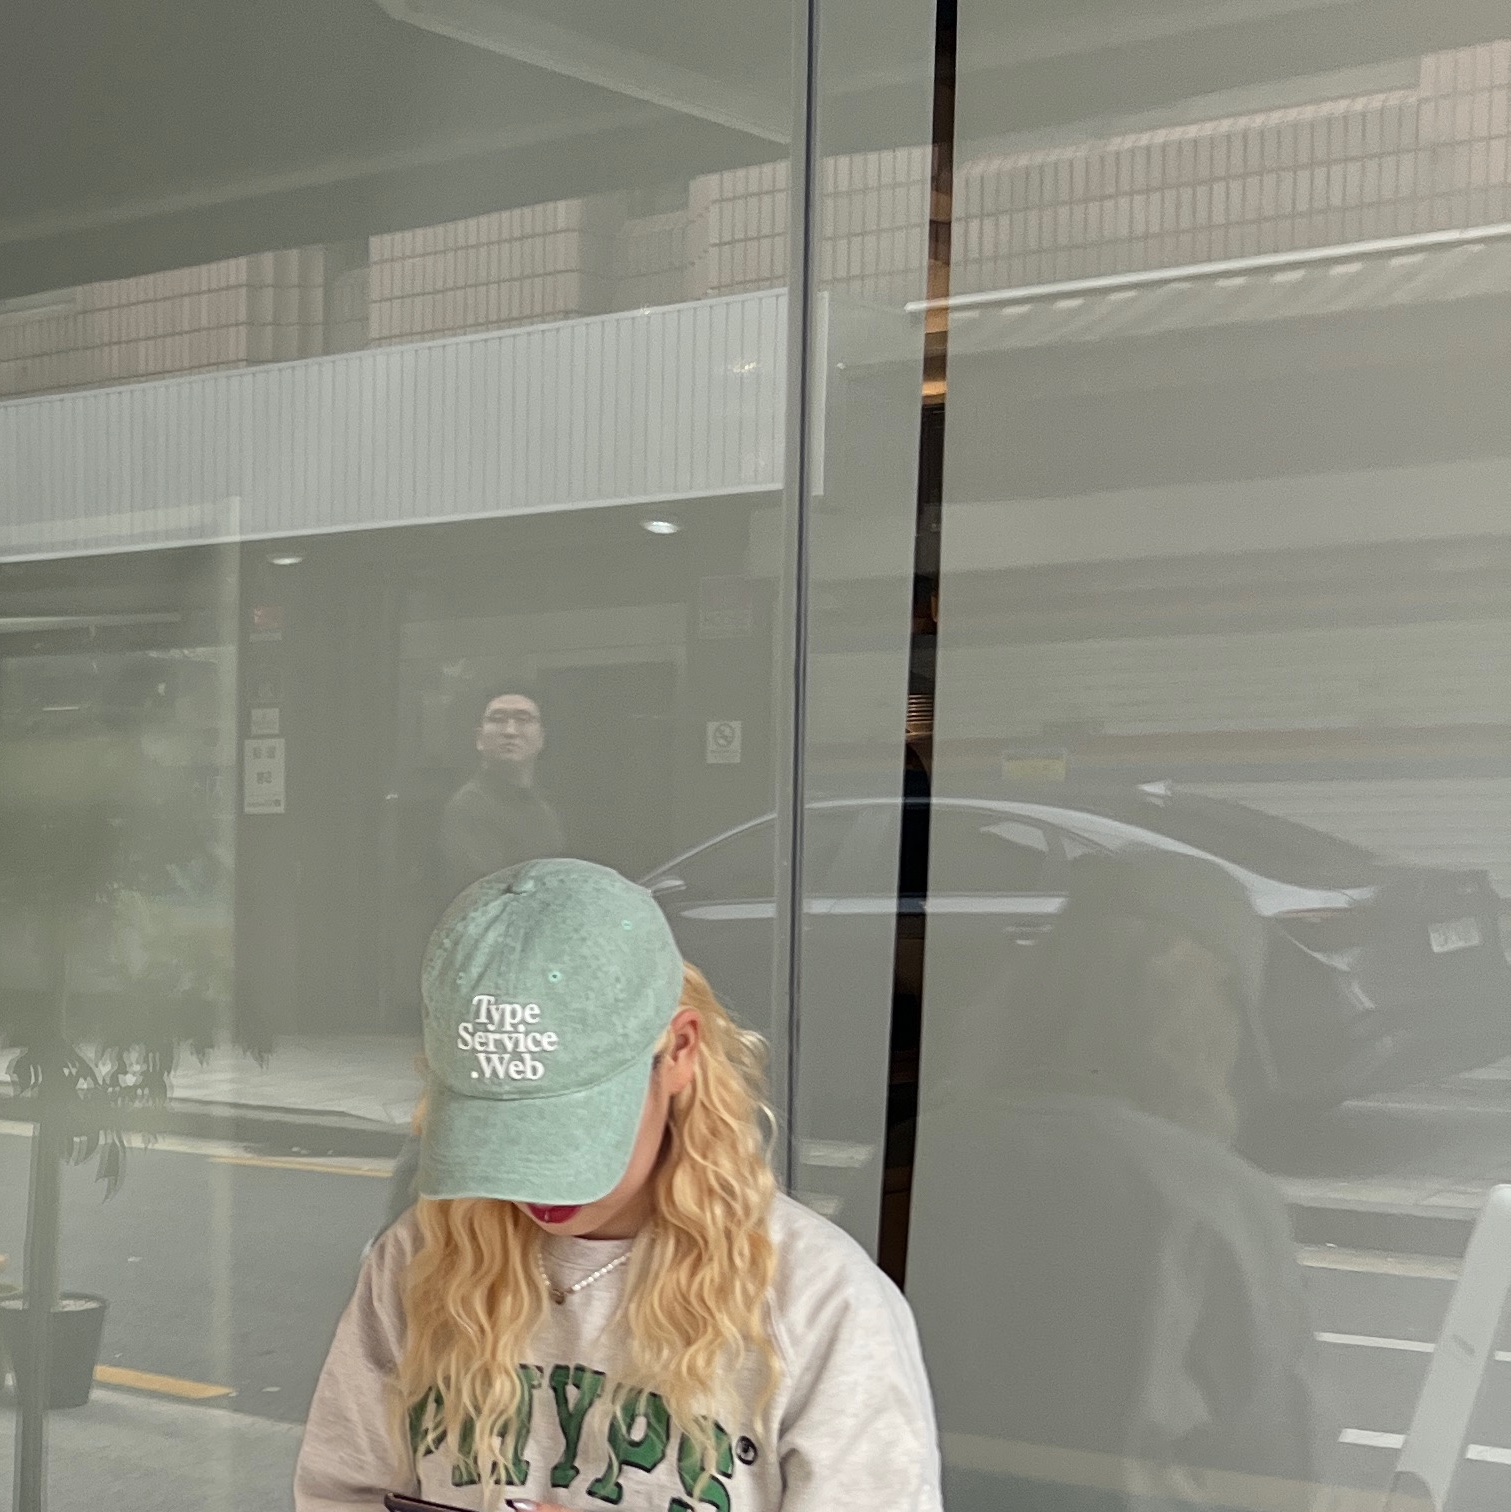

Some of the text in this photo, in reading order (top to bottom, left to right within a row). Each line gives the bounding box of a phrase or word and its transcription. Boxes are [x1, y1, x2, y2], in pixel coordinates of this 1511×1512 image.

[472, 994, 541, 1032] Type
[457, 1022, 559, 1053] Service
[470, 1053, 545, 1080] .Web
